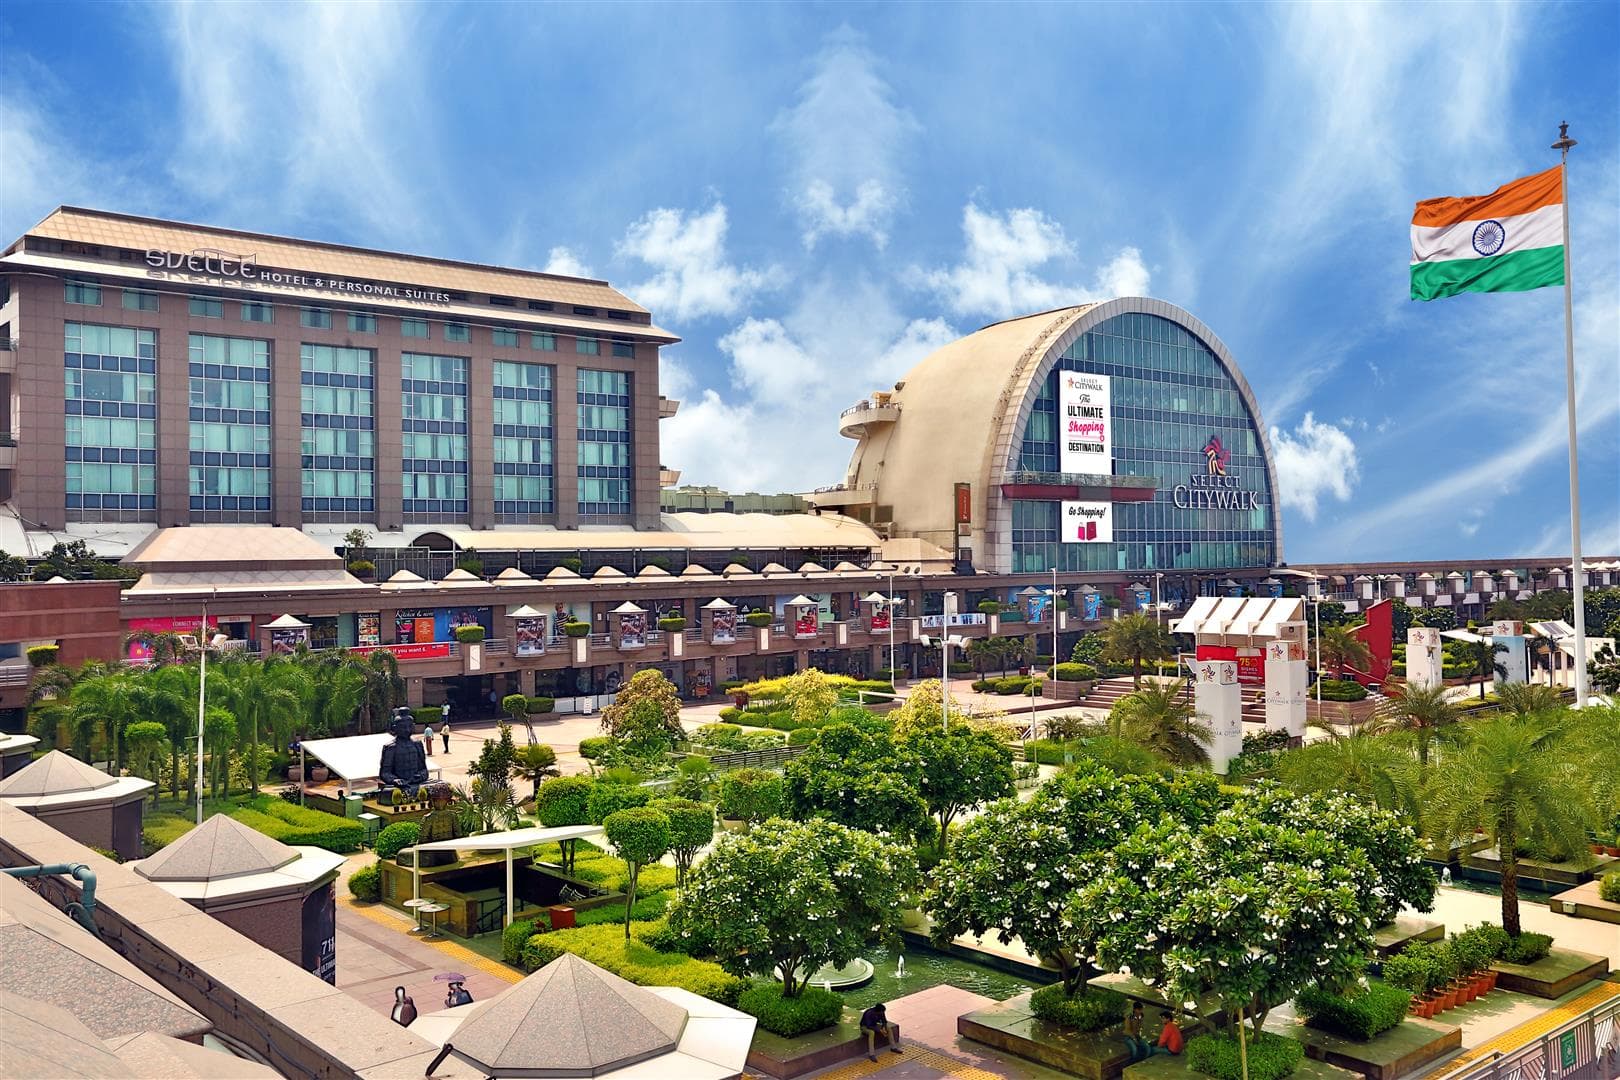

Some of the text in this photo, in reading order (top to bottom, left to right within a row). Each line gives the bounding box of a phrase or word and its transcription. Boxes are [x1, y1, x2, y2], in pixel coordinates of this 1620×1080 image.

[260, 271, 450, 302] HOTEL & PERSONAL SUITES
[1075, 381, 1103, 391] CITYWALK
[1067, 405, 1104, 419] ULTIMATE
[1068, 420, 1104, 436] Shopping
[1068, 442, 1104, 453] DESTINATION
[1191, 474, 1240, 488] SELECT
[1173, 484, 1259, 510] CITYWALK
[1069, 506, 1106, 519] Go Shopping!
